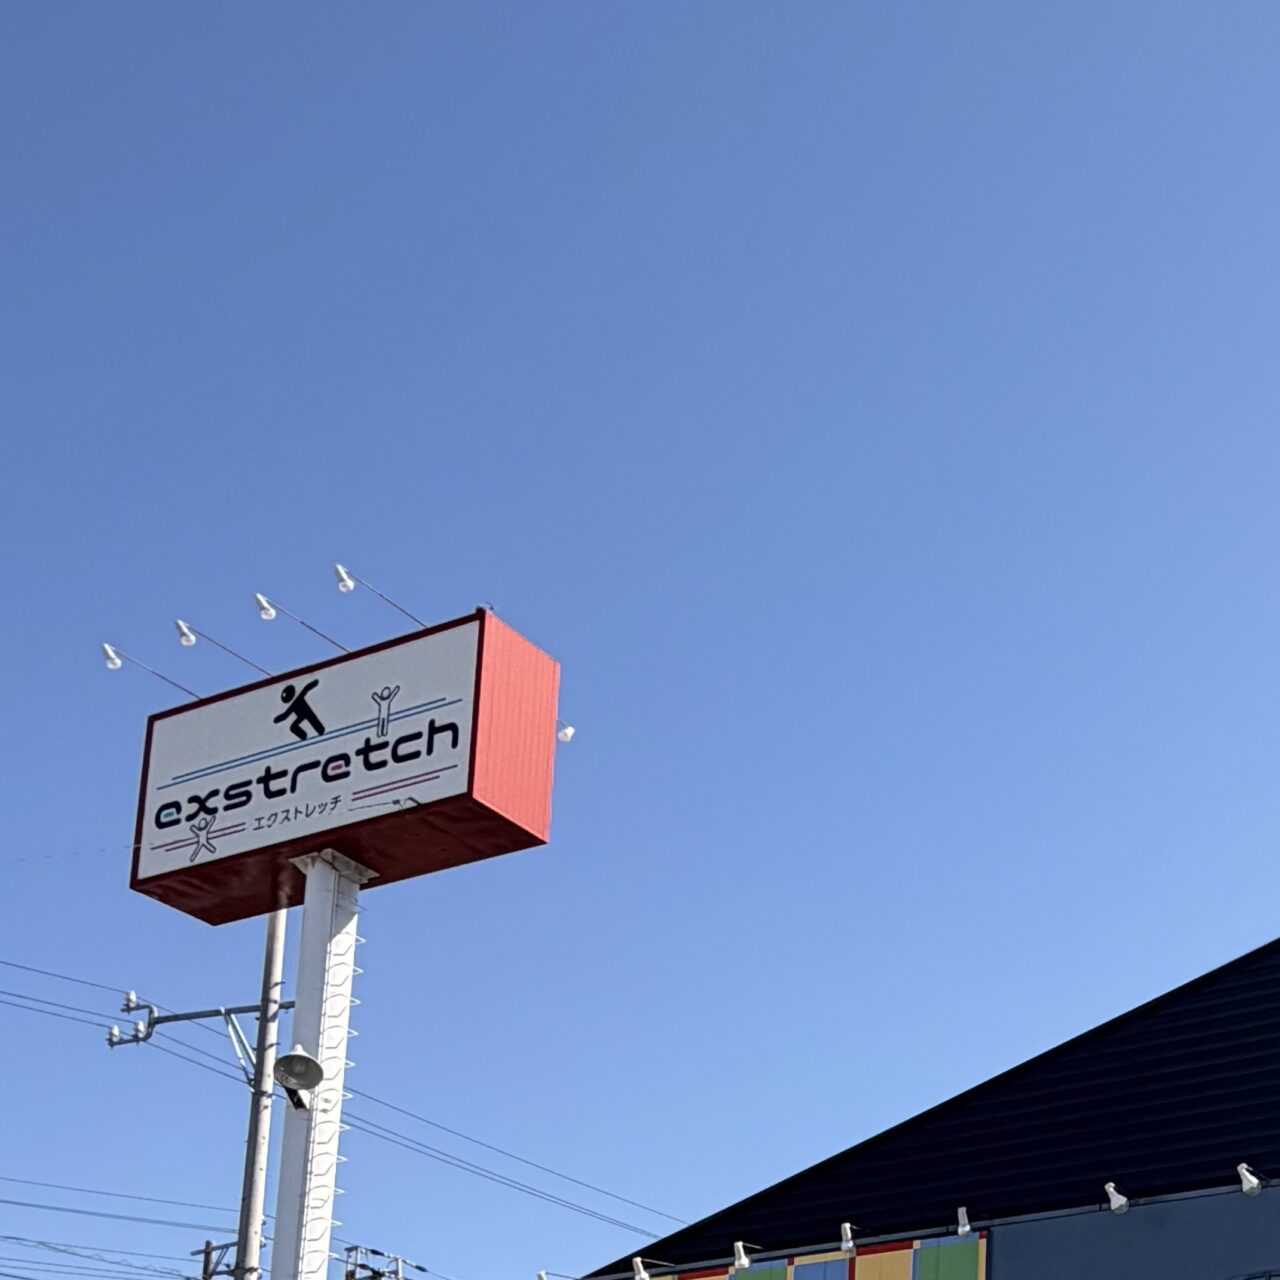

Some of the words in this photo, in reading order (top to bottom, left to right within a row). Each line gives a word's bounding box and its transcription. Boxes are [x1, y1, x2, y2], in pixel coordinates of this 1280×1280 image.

[154, 718, 459, 830] exstretch
[252, 795, 342, 832] エクストレッチ
